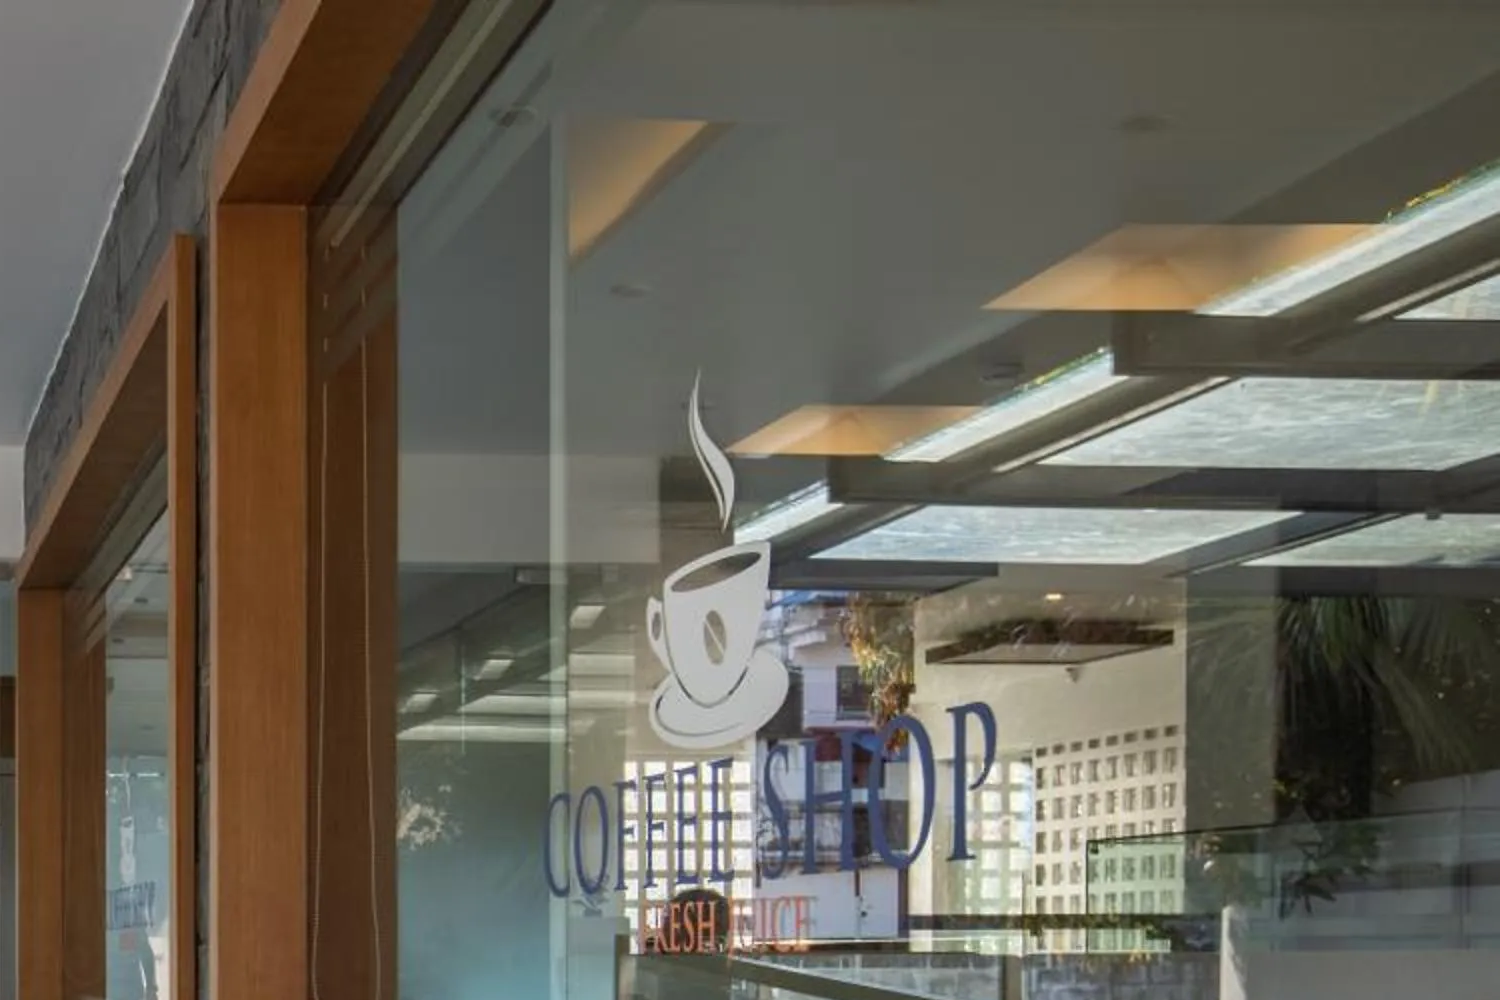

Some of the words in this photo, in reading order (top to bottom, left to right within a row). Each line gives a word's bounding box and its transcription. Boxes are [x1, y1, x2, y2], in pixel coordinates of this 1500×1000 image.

[543, 757, 735, 898] COFFEE
[761, 701, 997, 879] SHOP
[639, 898, 718, 955] FRESH
